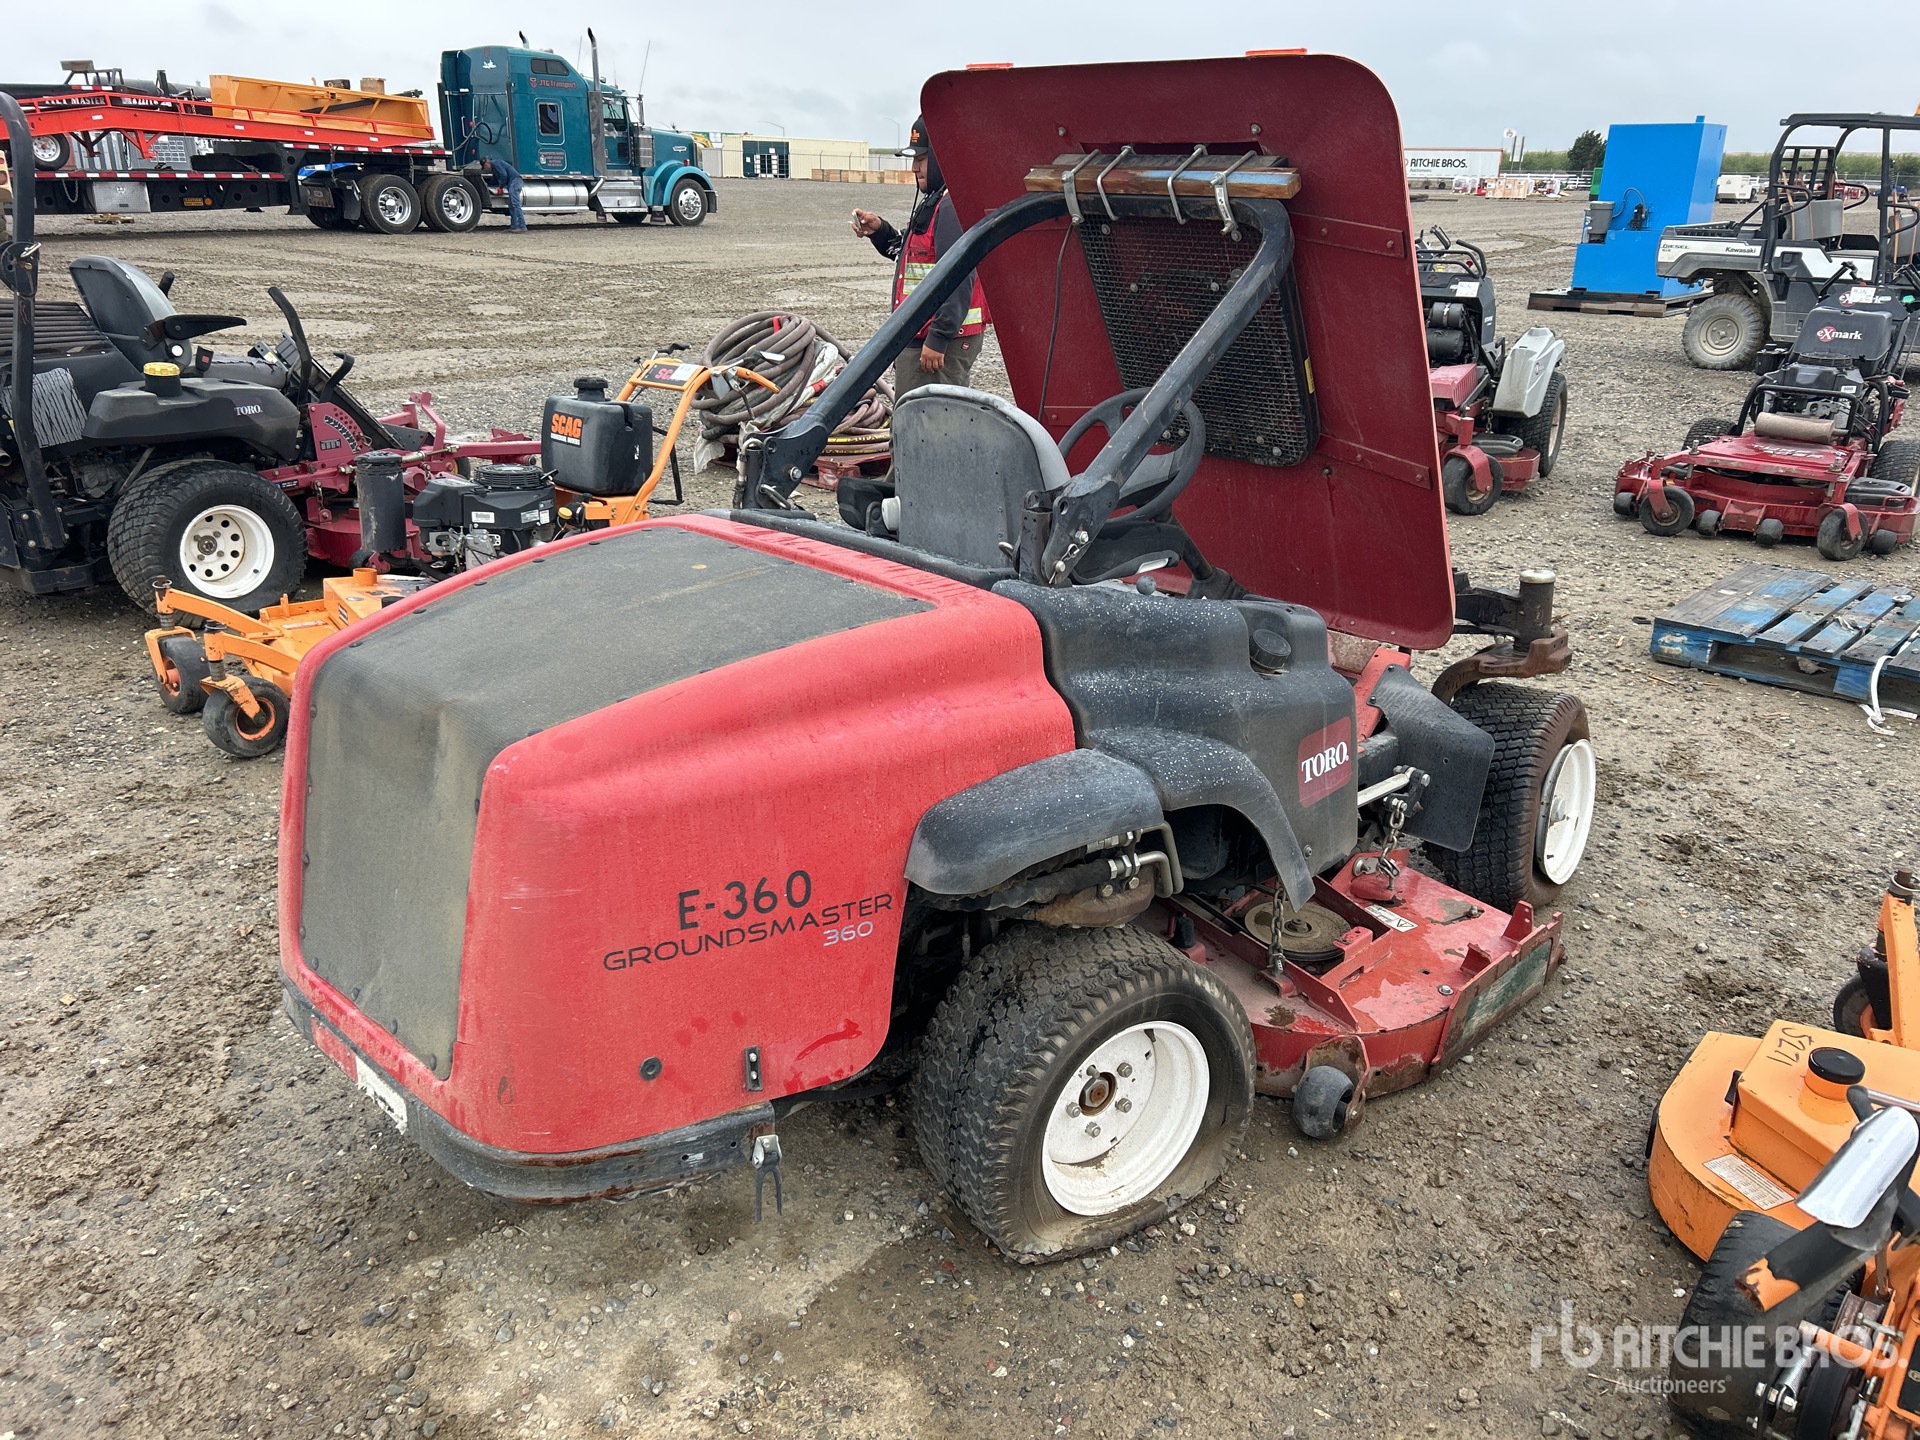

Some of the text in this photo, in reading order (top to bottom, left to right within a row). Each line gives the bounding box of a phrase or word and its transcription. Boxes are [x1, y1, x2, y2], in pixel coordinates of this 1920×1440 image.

[71, 96, 106, 105] MASTER
[1410, 158, 1468, 168] RITCHIE BROS.
[1725, 246, 1757, 254] Kawasaki
[234, 404, 262, 416] TORO
[551, 413, 582, 439] SCAG
[1301, 741, 1349, 784] TORO
[678, 869, 812, 930] E-360
[603, 893, 894, 971] GROUNDSMASTER
[822, 920, 874, 947] 360
